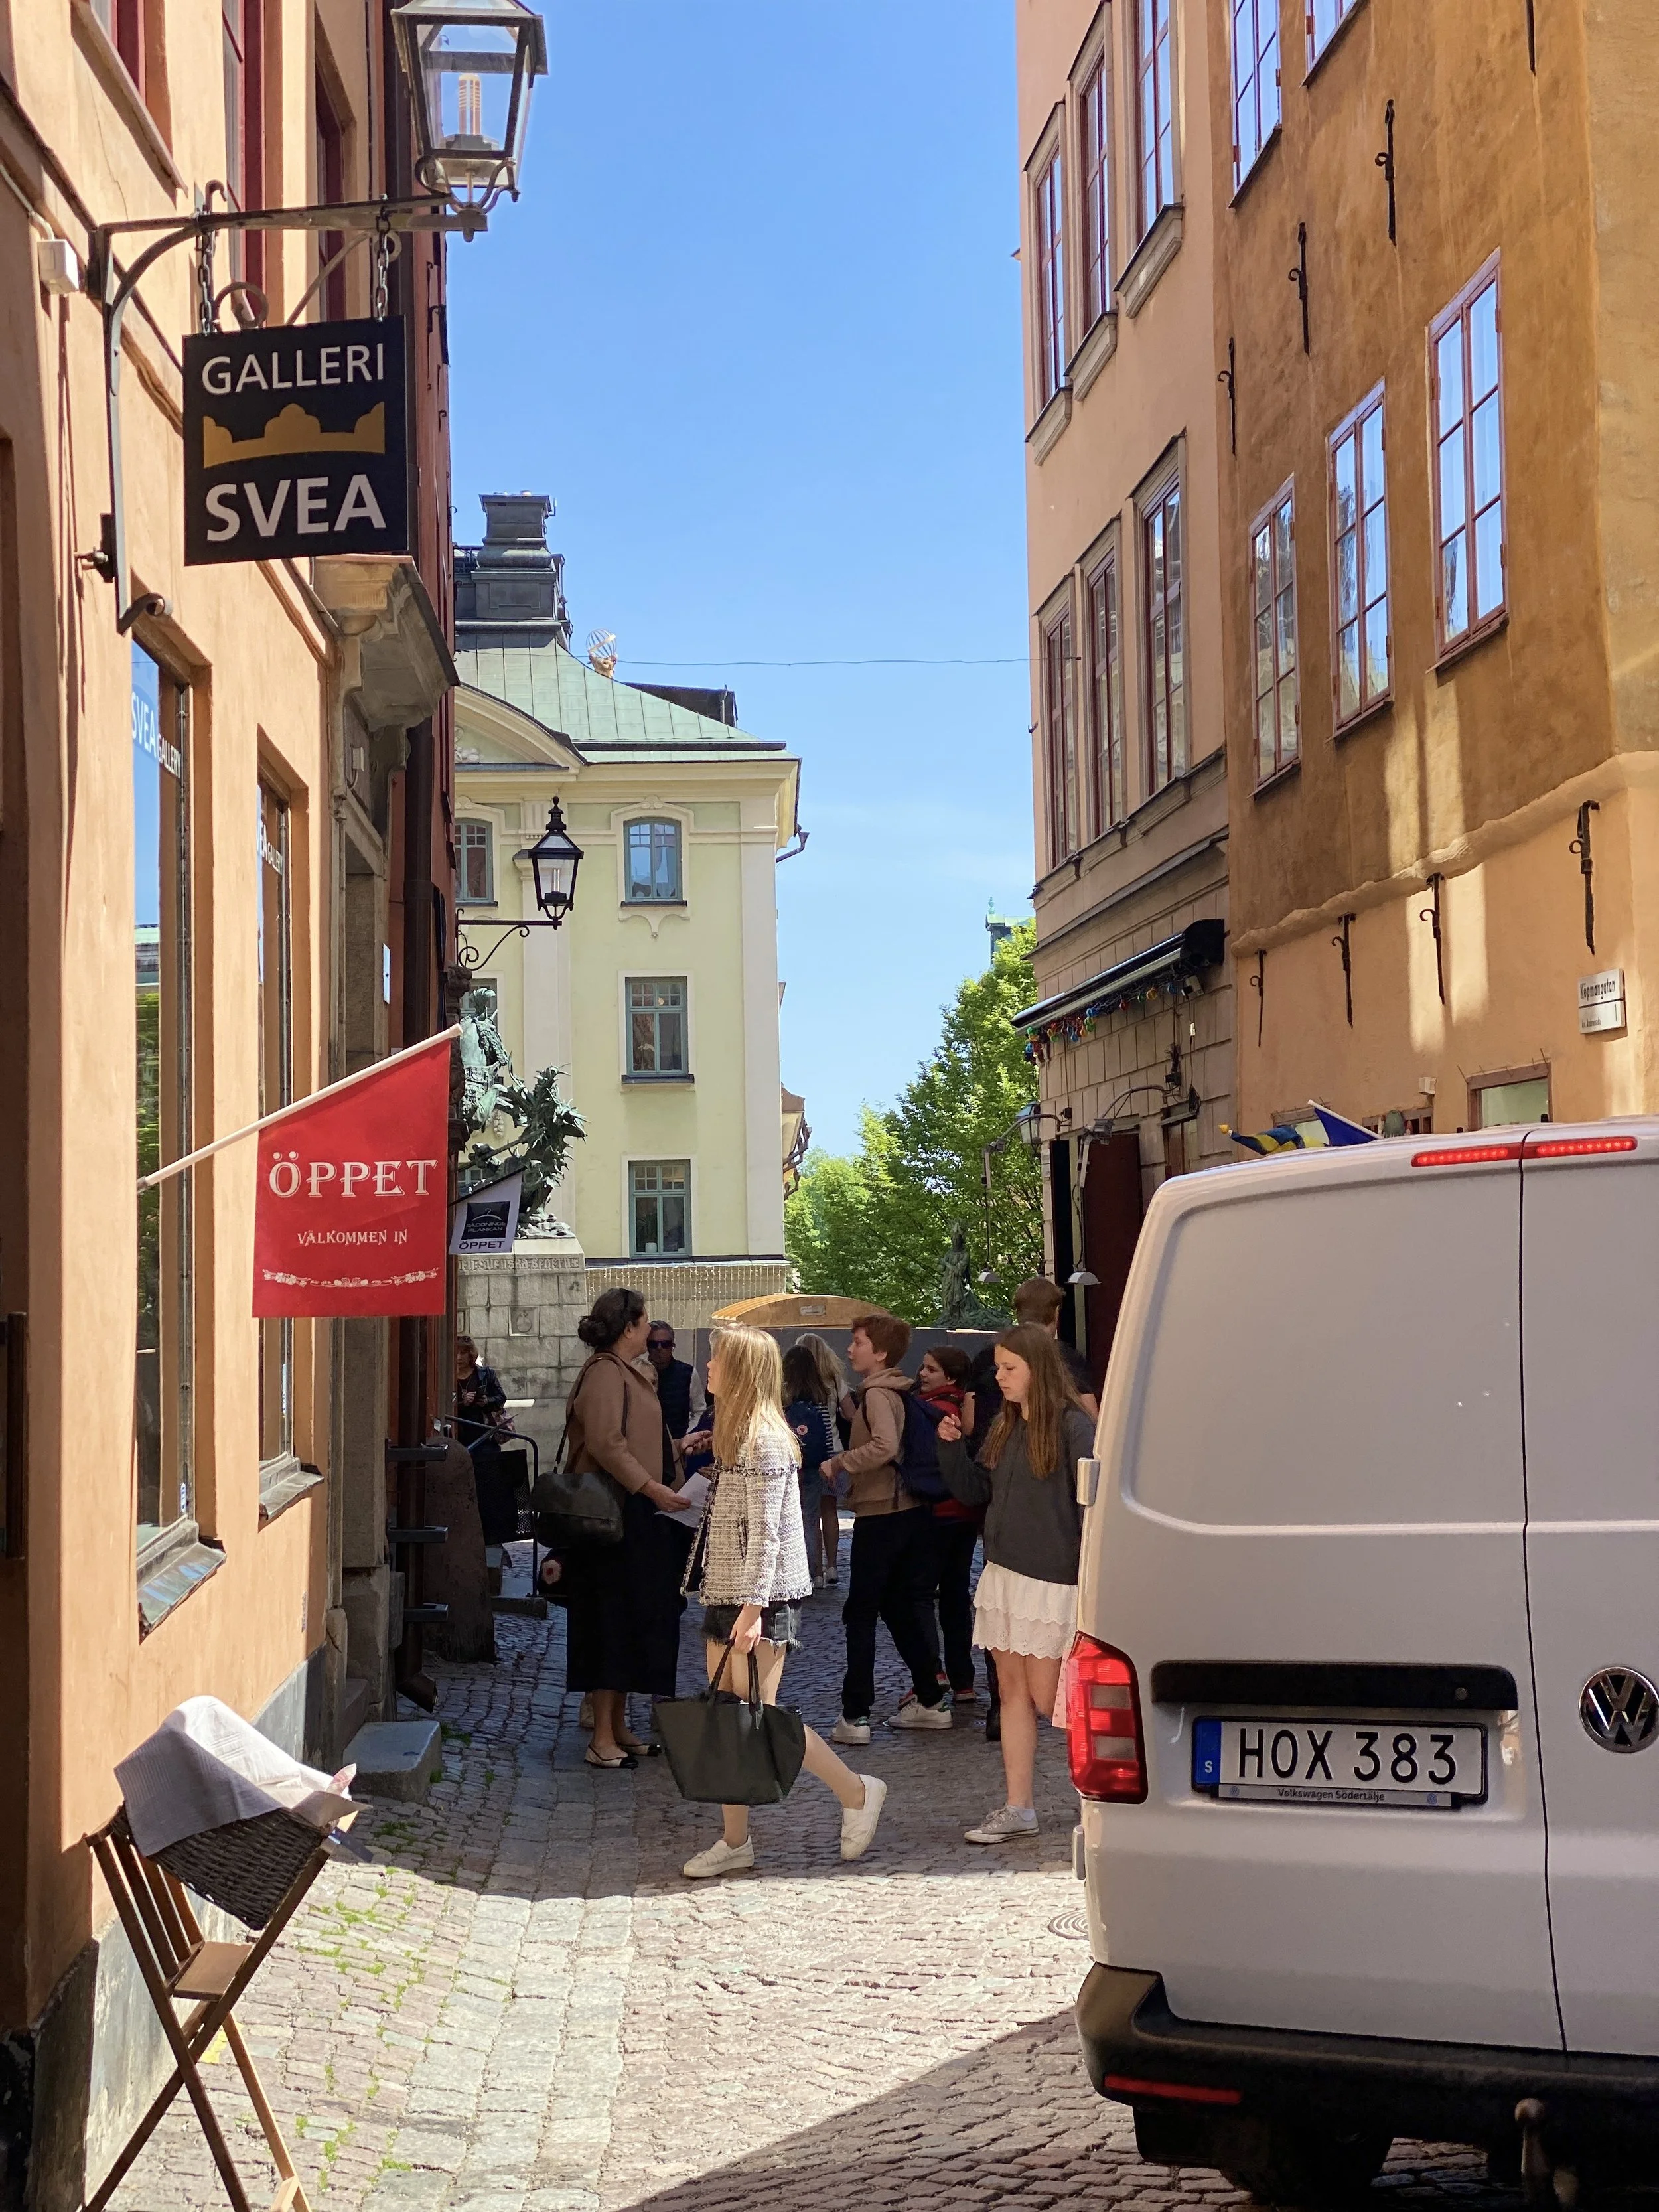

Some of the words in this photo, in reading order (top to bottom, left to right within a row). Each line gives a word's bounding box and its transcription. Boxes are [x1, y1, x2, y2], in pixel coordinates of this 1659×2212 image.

[201, 343, 384, 395] GALLERI
[206, 474, 386, 542] SVEA
[132, 691, 157, 758] SVEA
[157, 733, 181, 778] GALLERY
[269, 1151, 439, 1197] ÖPPET
[297, 1230, 387, 1246] VÄLKOMMEN
[394, 1228, 407, 1245] IN
[459, 1240, 505, 1250] ÖPPET
[1204, 1760, 1213, 1773] S
[1239, 1728, 1333, 1780] HOX
[1353, 1731, 1457, 1785] 383
[1277, 1788, 1333, 1800] Volkswagen
[1336, 1790, 1385, 1803] Södertälje
